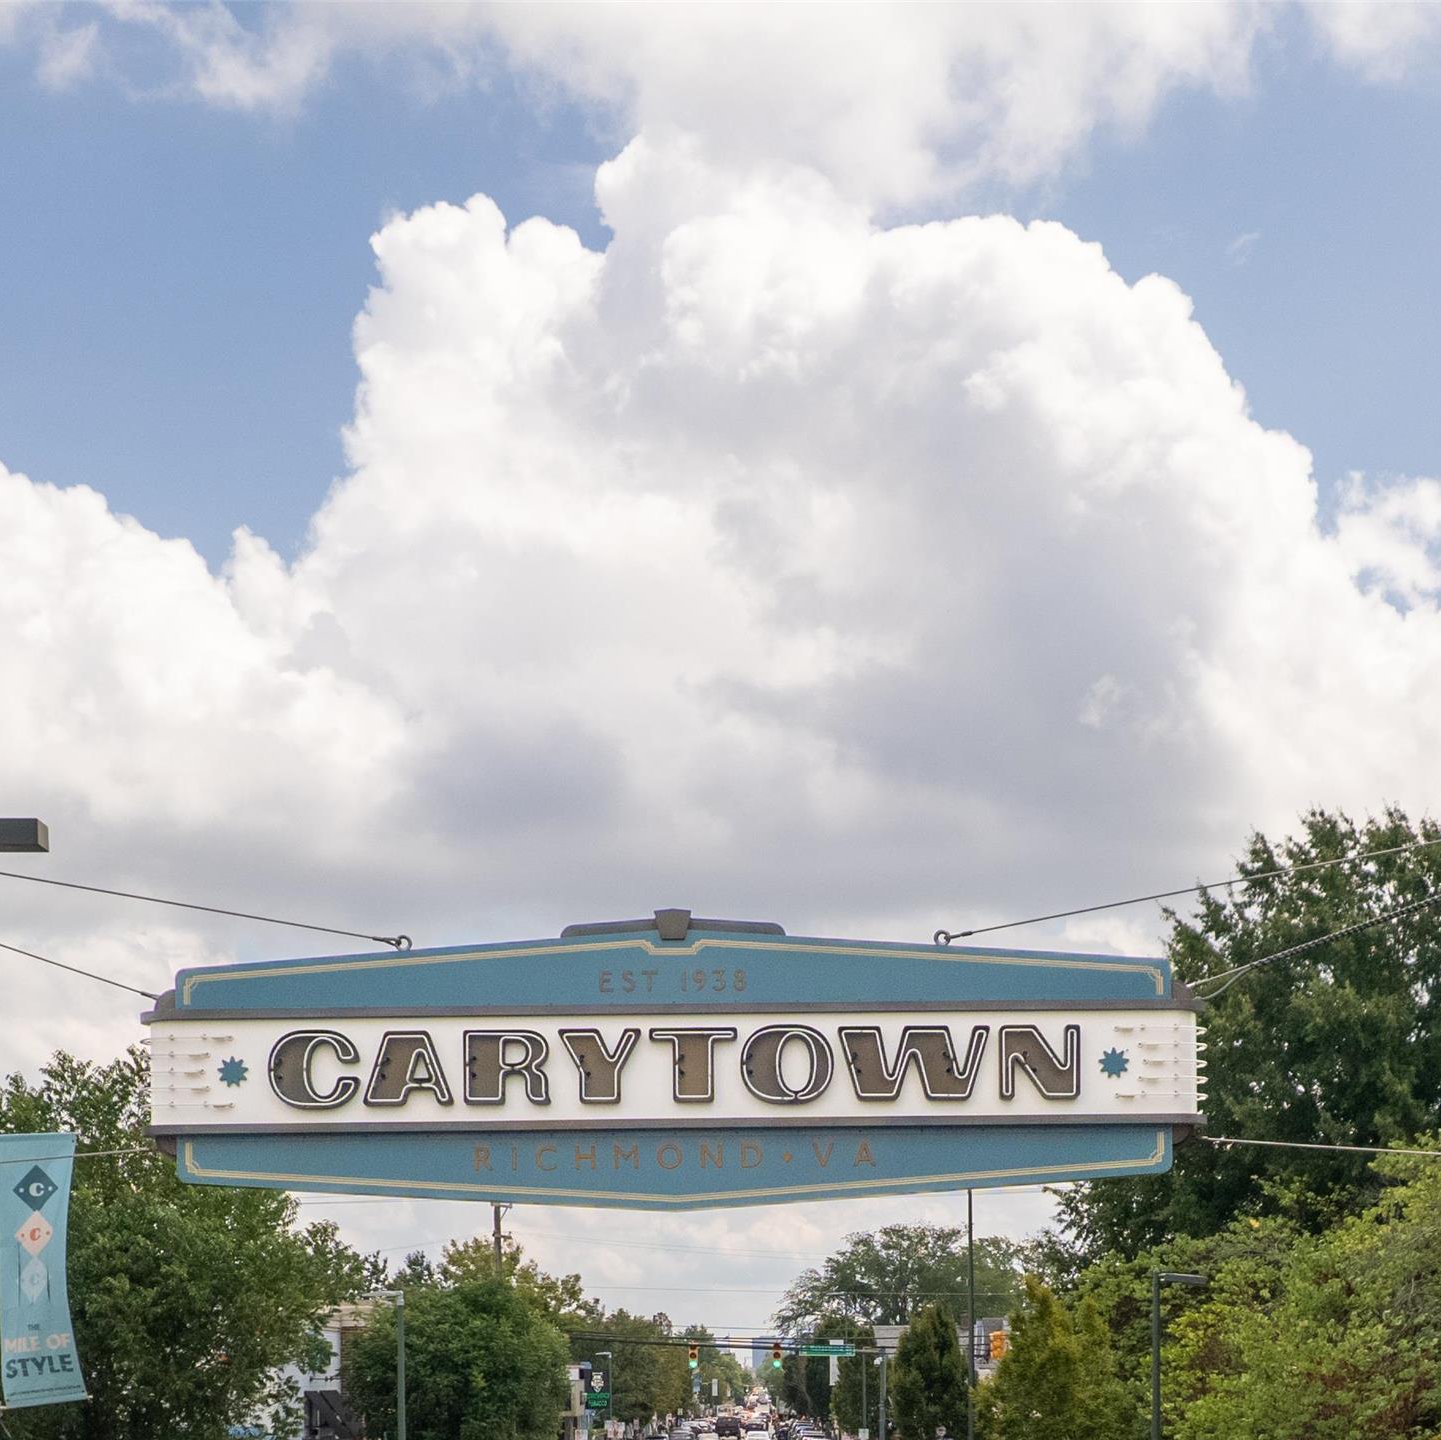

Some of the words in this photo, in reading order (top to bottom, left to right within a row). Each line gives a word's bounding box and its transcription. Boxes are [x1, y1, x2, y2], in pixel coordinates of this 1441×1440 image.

[598, 969, 657, 993] EST
[680, 968, 747, 993] 1938
[267, 1023, 1081, 1110] CARYTOWN
[473, 1141, 762, 1171] RICHMOND
[813, 1140, 876, 1168] VA
[4, 1336, 39, 1353] MILE
[46, 1332, 70, 1350] OF
[5, 1354, 73, 1379] STYLE
